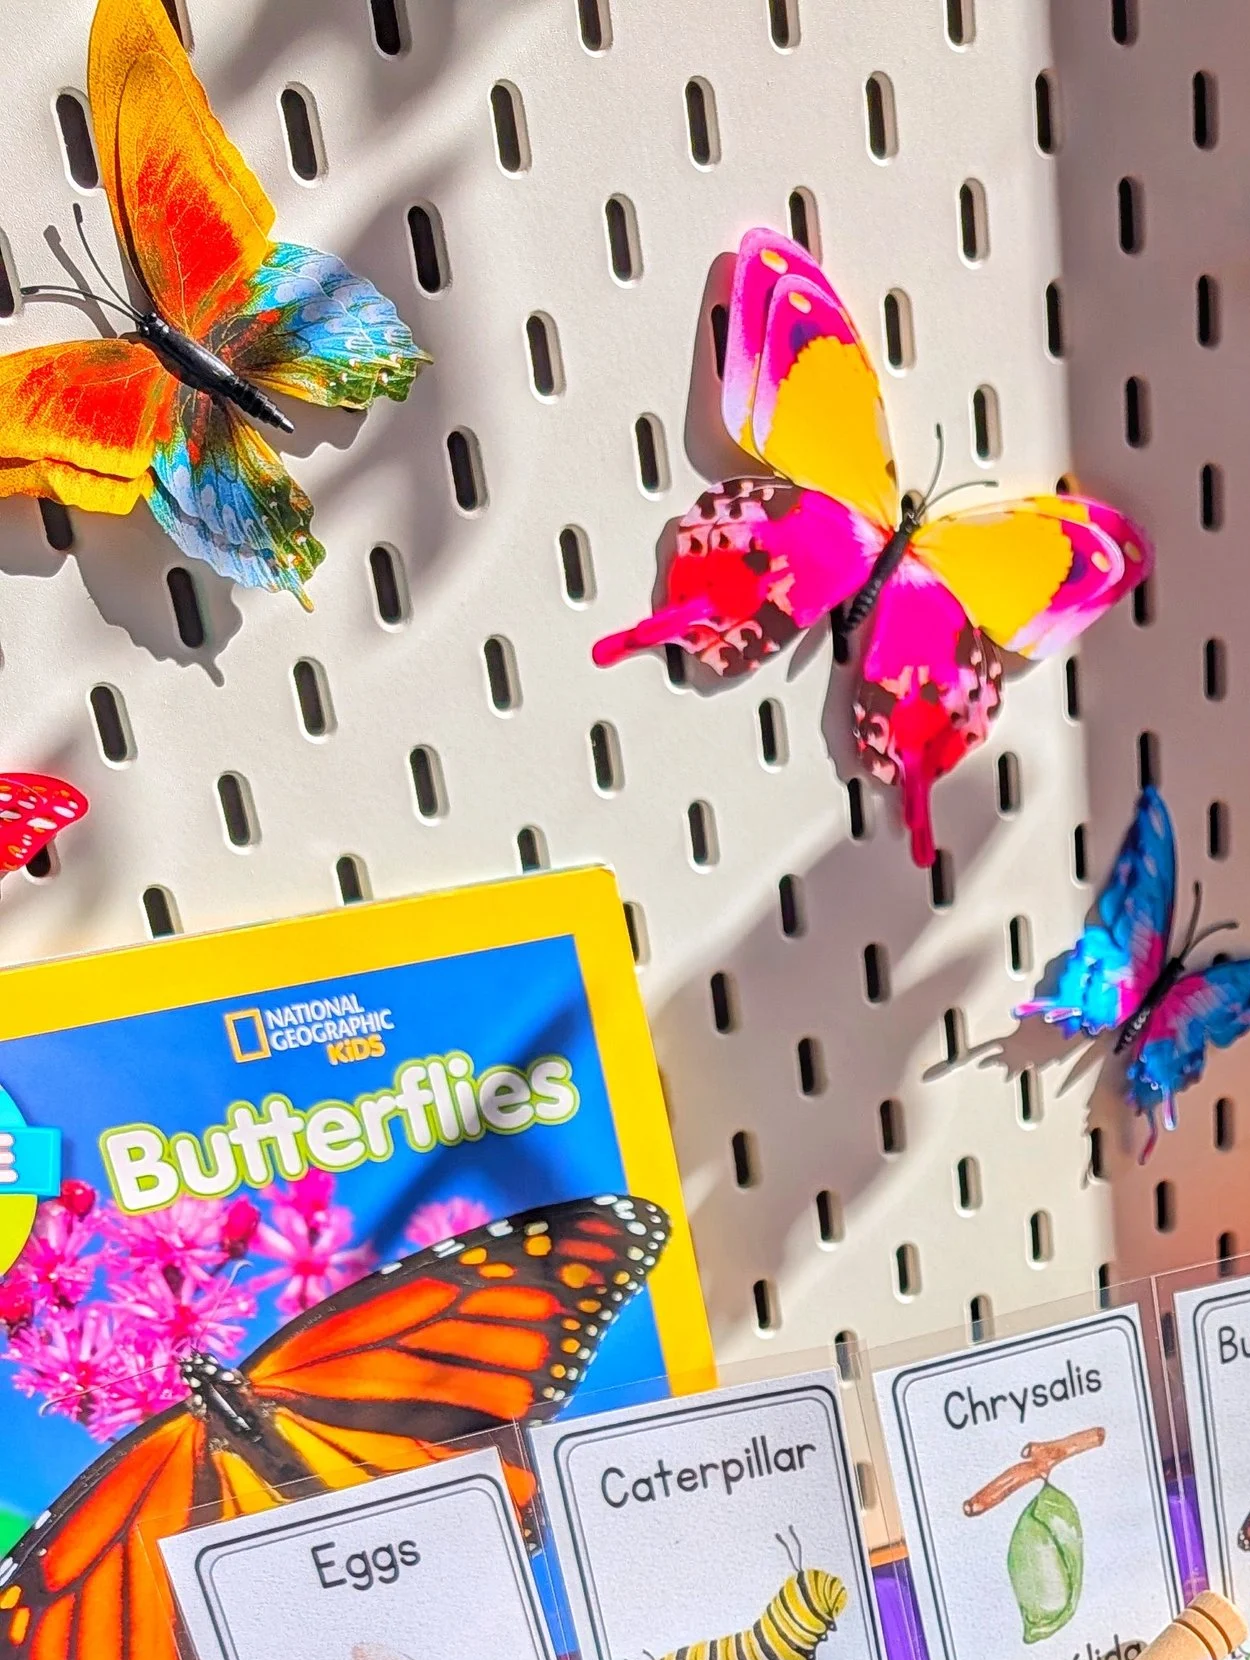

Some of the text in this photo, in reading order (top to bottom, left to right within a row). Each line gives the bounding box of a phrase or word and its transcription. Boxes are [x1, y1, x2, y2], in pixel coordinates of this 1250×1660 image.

[265, 993, 365, 1029] NATIONAL
[270, 1008, 395, 1051] GEOGRAPHIC
[101, 1051, 578, 1215] Butterflies
[944, 1360, 1102, 1430] Chrysalis
[601, 1437, 816, 1508] Caterpillar
[312, 1536, 421, 1590] Eggs
